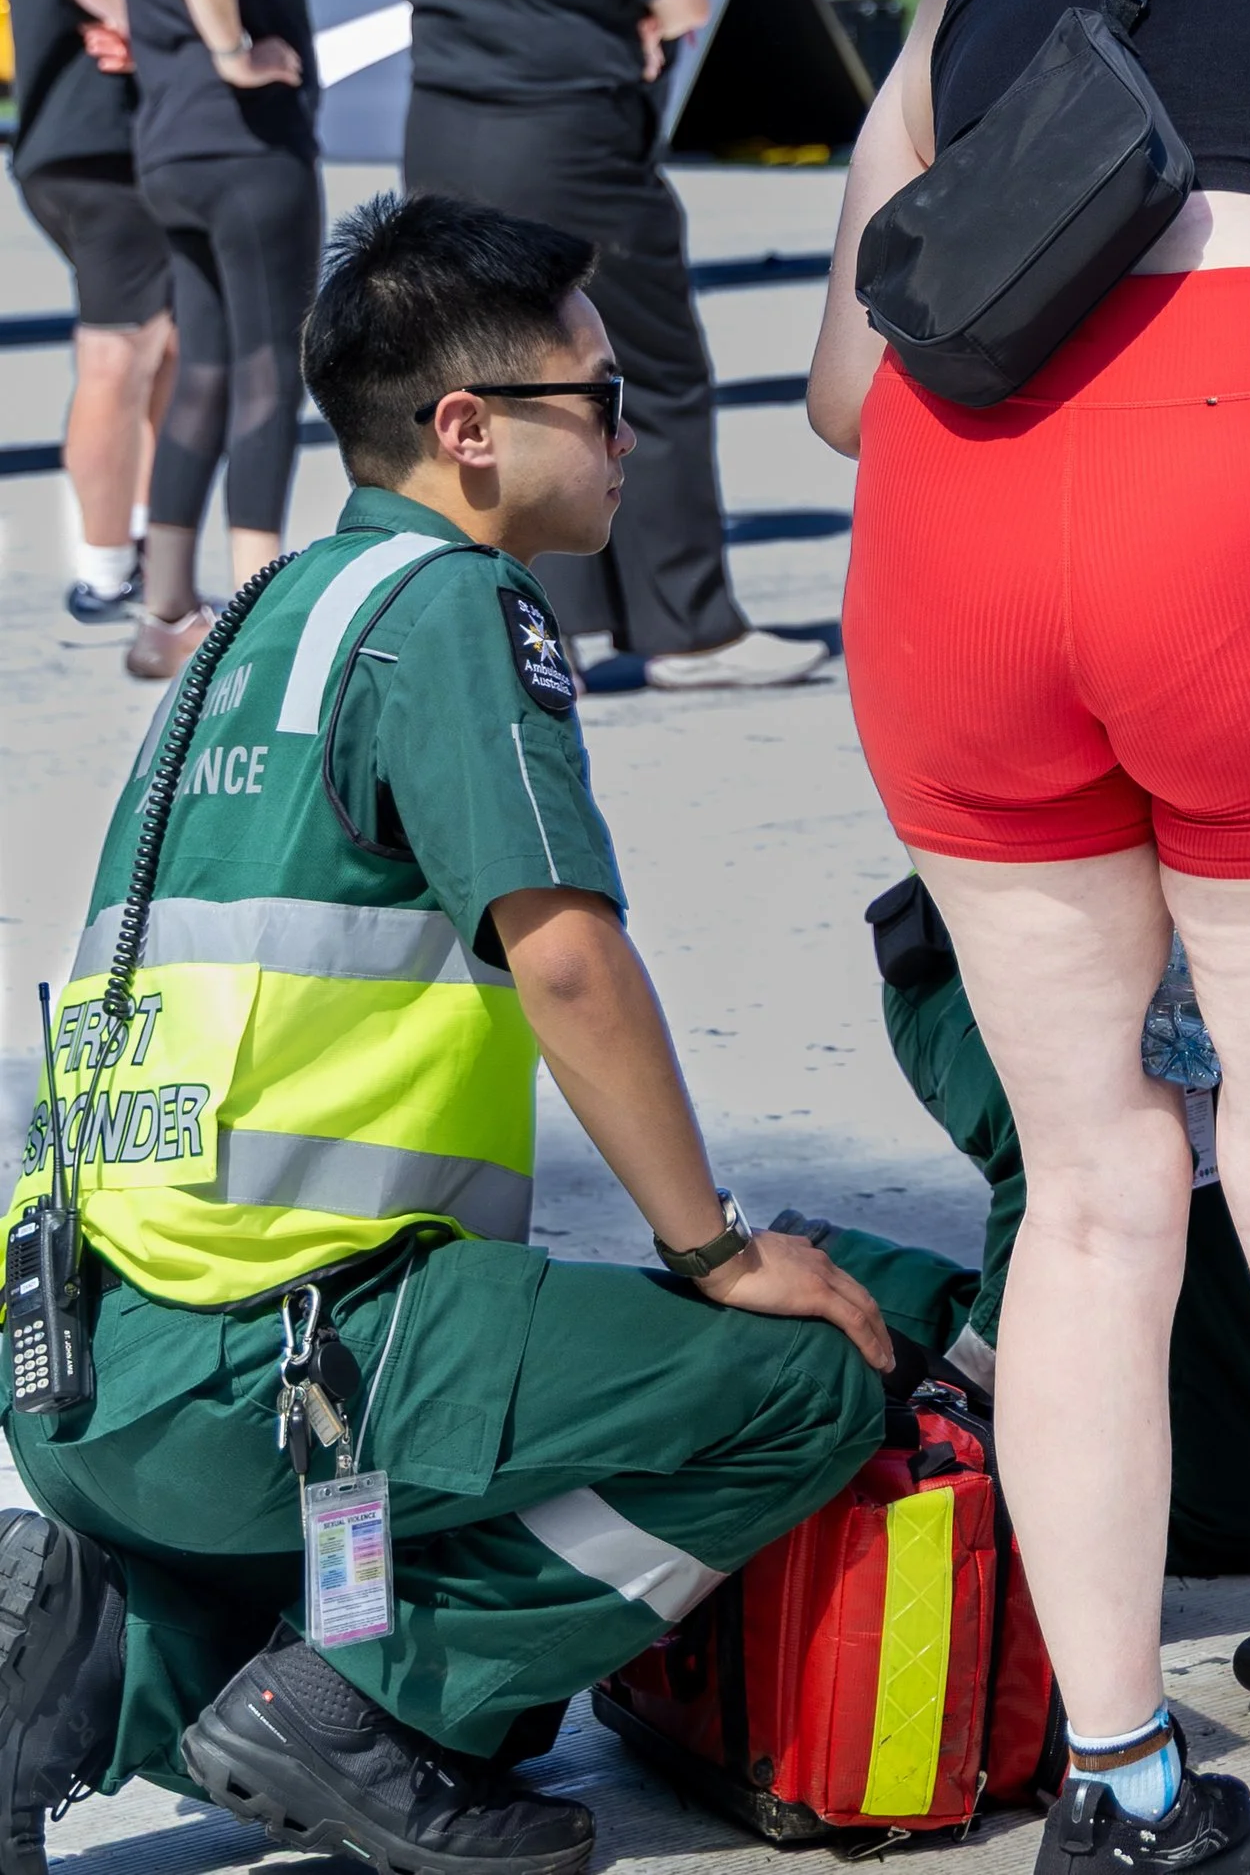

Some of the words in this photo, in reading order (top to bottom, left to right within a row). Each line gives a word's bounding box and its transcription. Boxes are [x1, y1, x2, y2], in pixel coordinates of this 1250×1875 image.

[524, 658, 571, 685] Ambulance
[532, 672, 572, 696] Australia
[323, 1518, 346, 1530] SEXUAL
[347, 1512, 376, 1524] VIOLENCE
